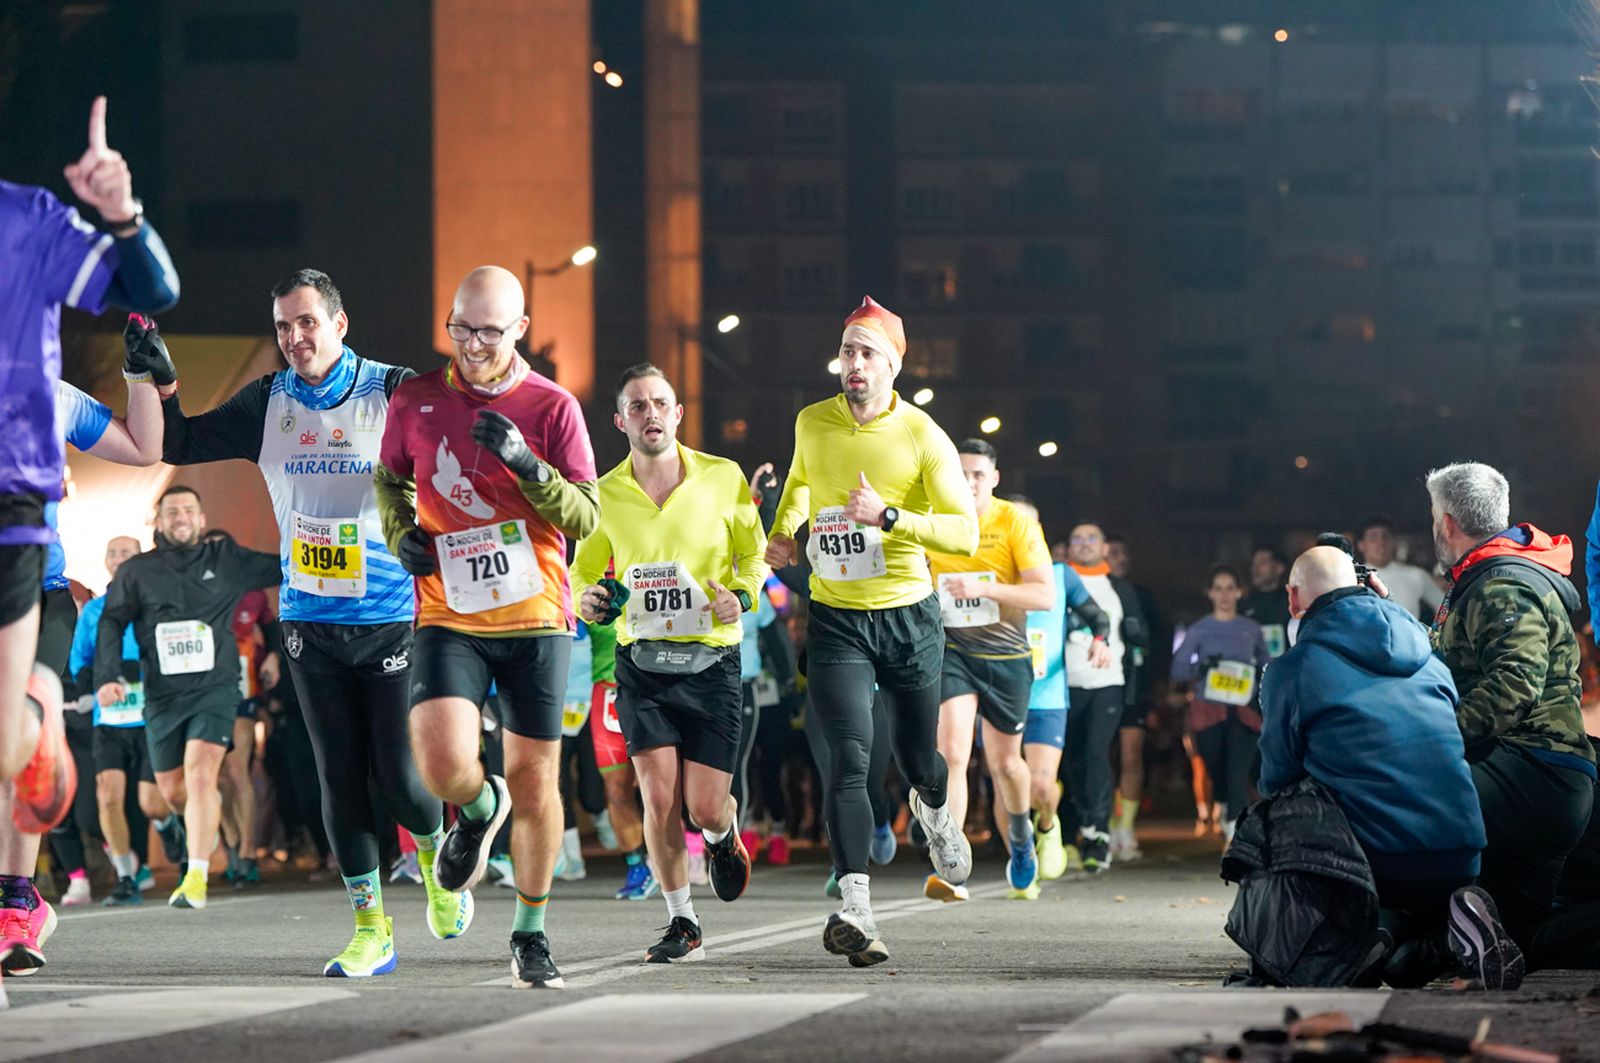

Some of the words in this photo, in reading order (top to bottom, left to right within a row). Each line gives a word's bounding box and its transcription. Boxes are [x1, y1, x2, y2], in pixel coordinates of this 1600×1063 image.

[284, 460, 372, 475] MARACENA
[450, 484, 473, 507] 43
[296, 530, 309, 541] SAN
[320, 527, 332, 536] DE
[811, 526, 823, 534] AN
[457, 535, 481, 546] NOCHE
[482, 531, 494, 541] DE
[819, 531, 866, 556] 4319
[301, 543, 348, 571] 3194
[449, 548, 466, 560] SAN
[466, 550, 510, 582] 720
[642, 569, 666, 578] NOCHE
[667, 568, 677, 578] DE
[634, 580, 652, 590] SAN
[643, 587, 693, 613] 6781
[167, 639, 203, 656] 5060
[382, 655, 409, 673] als
